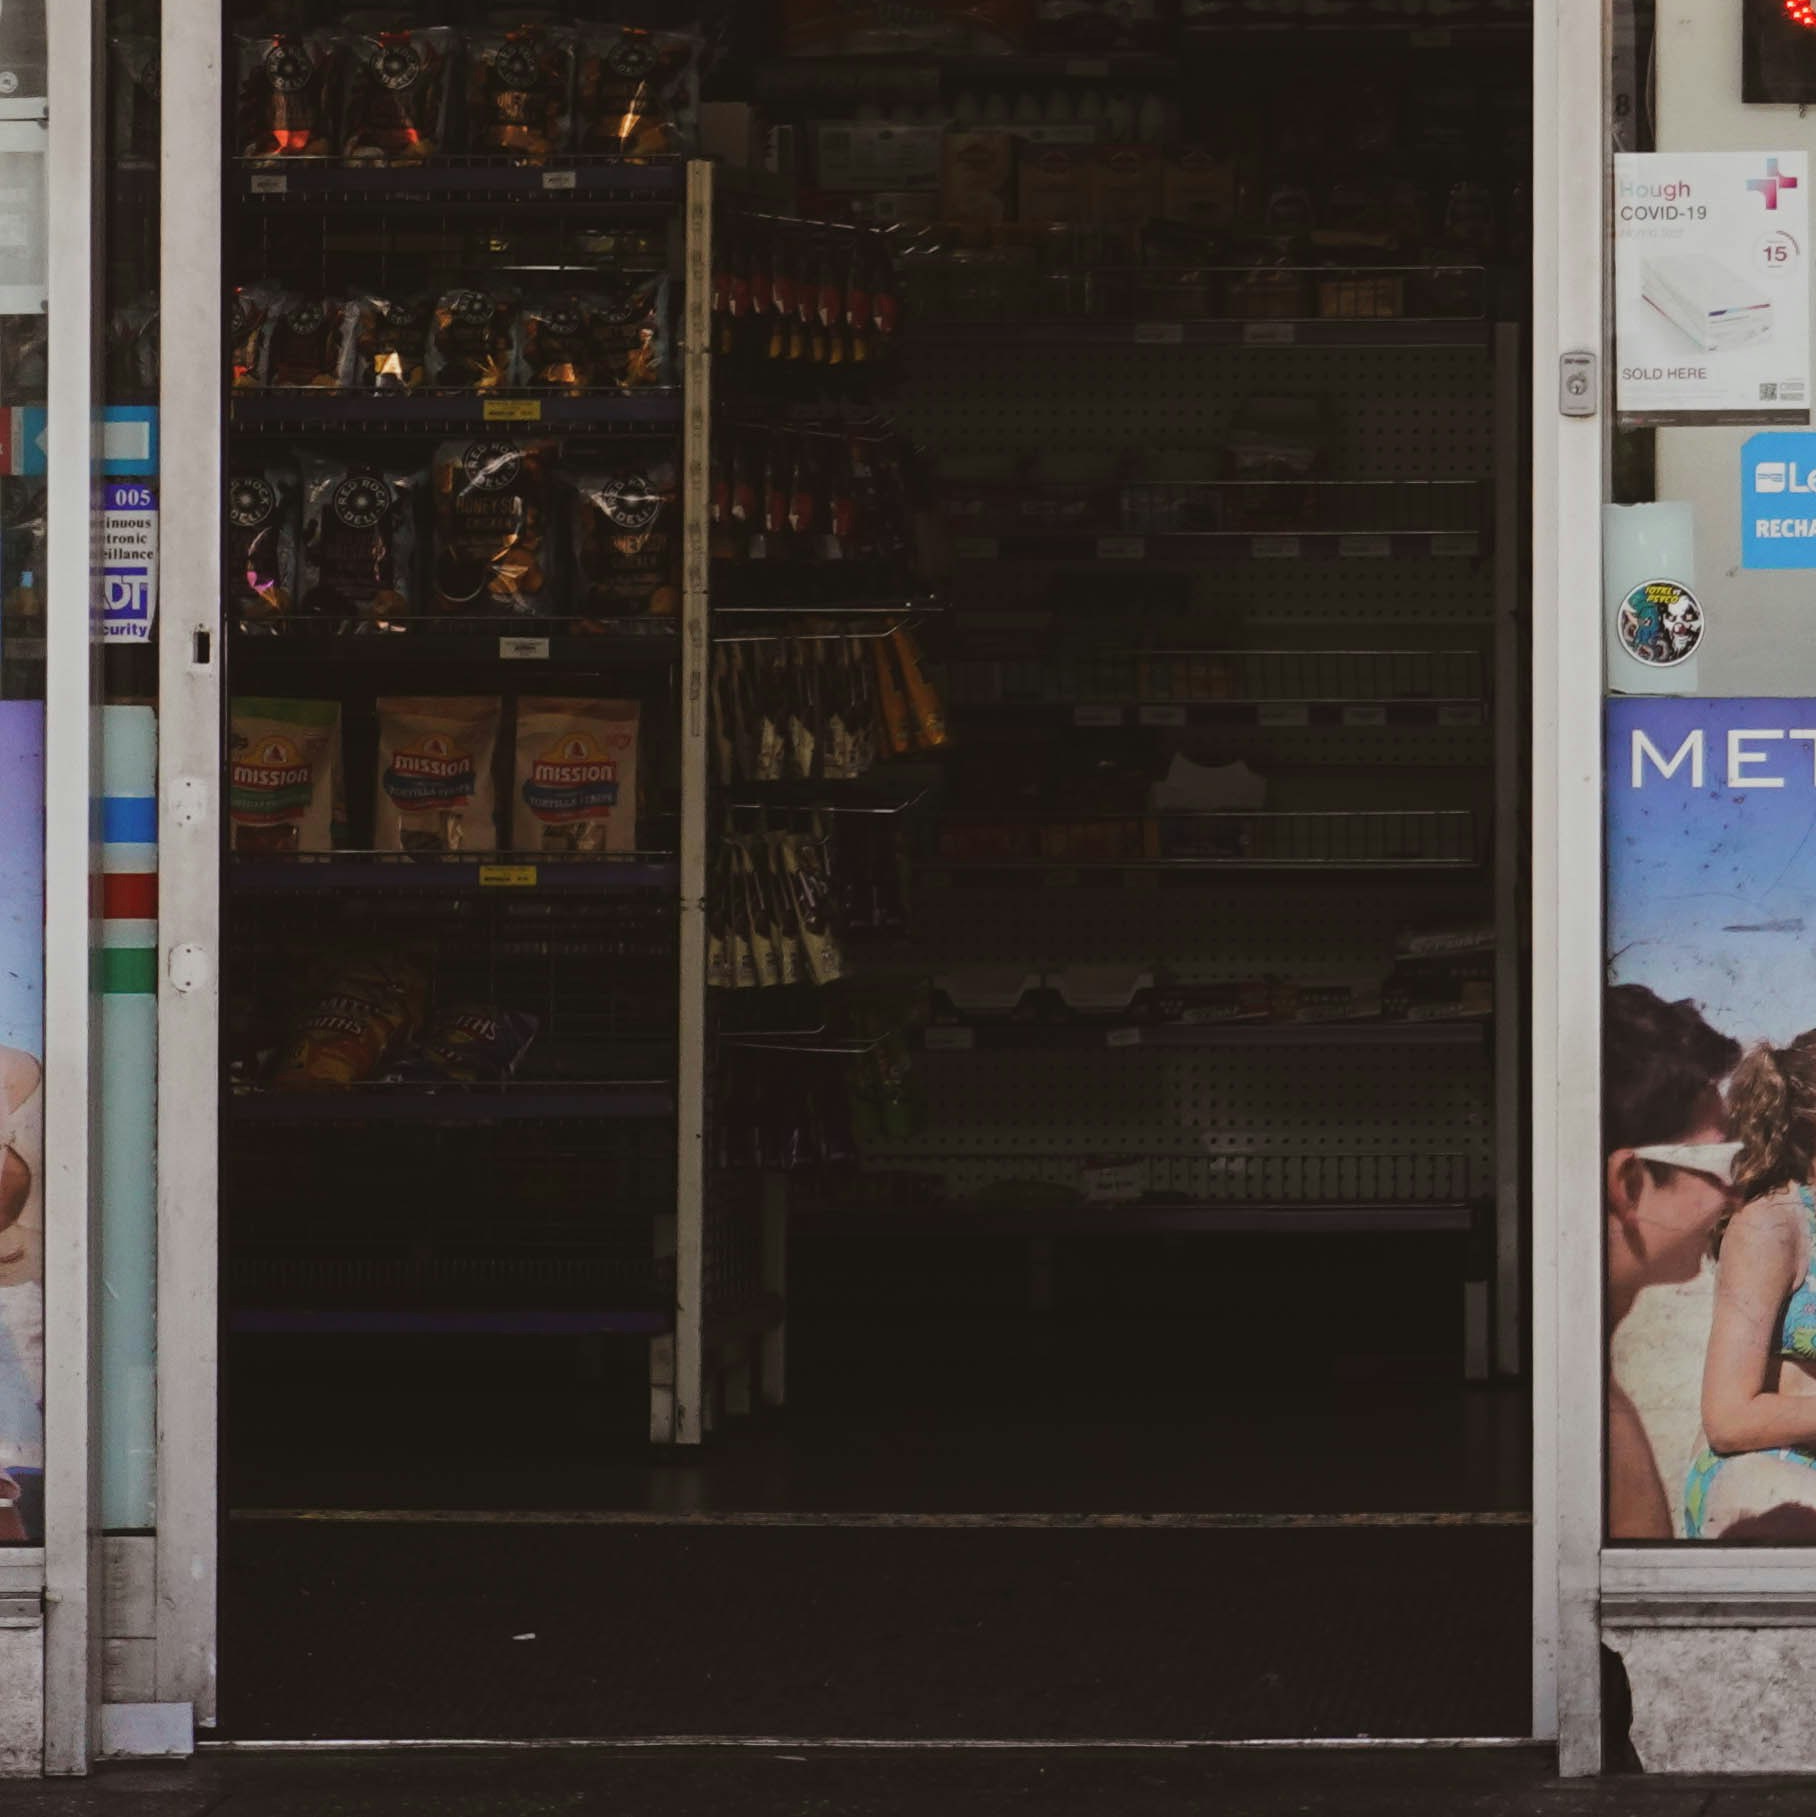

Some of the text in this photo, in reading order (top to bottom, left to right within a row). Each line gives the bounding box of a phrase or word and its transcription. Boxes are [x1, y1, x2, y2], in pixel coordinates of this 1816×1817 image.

[1620, 205, 1707, 221] COVID-19
[1763, 246, 1788, 262] 15
[1622, 367, 1707, 380] SOLD HERE
[115, 488, 151, 506] 005
[106, 517, 152, 529] inuous
[106, 534, 147, 545] tronic
[104, 548, 154, 560] eillance
[104, 575, 147, 611] DT
[104, 623, 148, 637] curity
